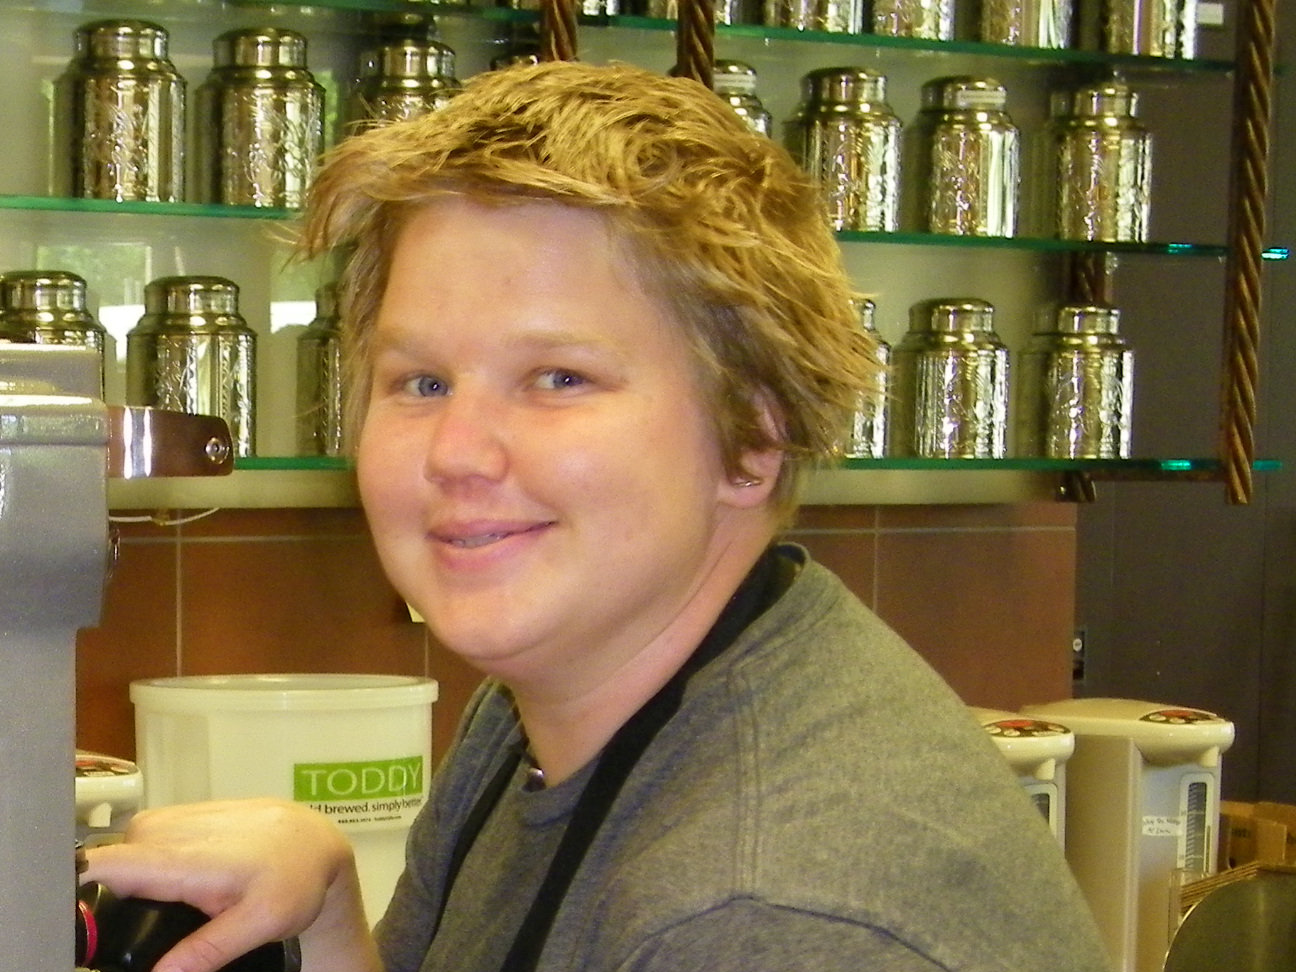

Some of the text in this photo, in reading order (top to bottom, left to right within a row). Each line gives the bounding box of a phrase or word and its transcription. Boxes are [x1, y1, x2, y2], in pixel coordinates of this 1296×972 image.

[301, 762, 421, 796] TODDY
[324, 802, 371, 814] brewed.
[372, 800, 402, 813] simply
